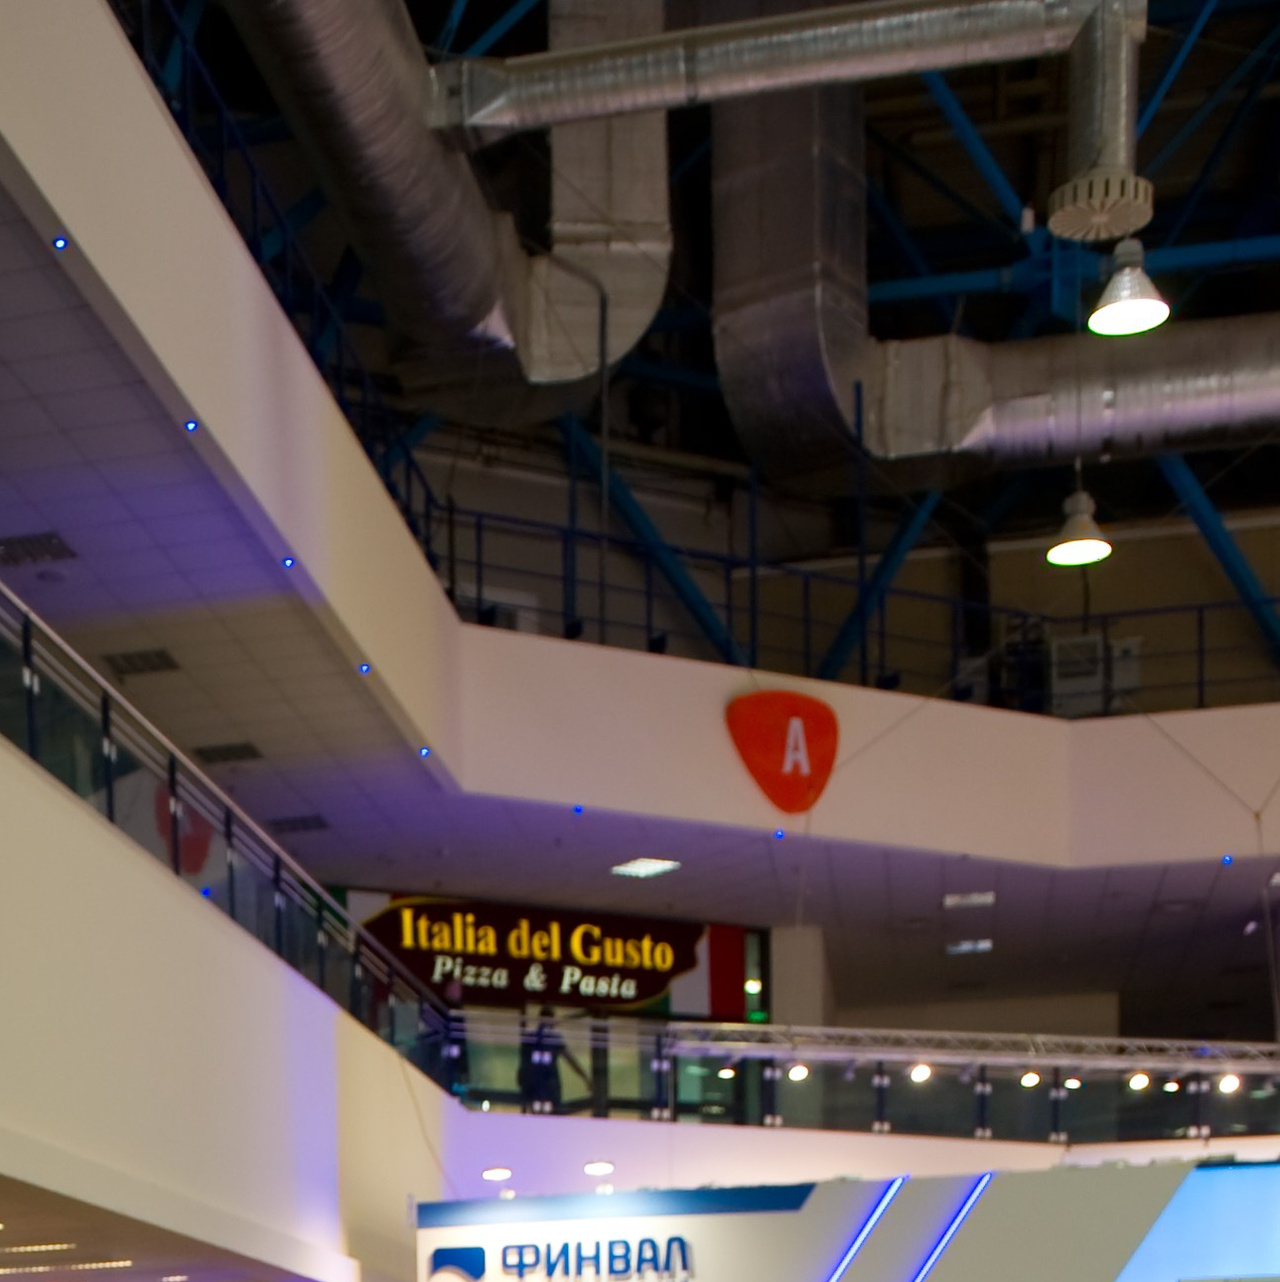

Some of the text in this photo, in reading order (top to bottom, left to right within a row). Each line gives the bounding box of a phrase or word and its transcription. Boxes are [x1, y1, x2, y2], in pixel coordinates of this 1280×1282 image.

[400, 906, 675, 973] Italia del Gusto
[431, 954, 638, 999] Pizza & Pasta
[501, 1236, 690, 1279] ФИНВАЛ
